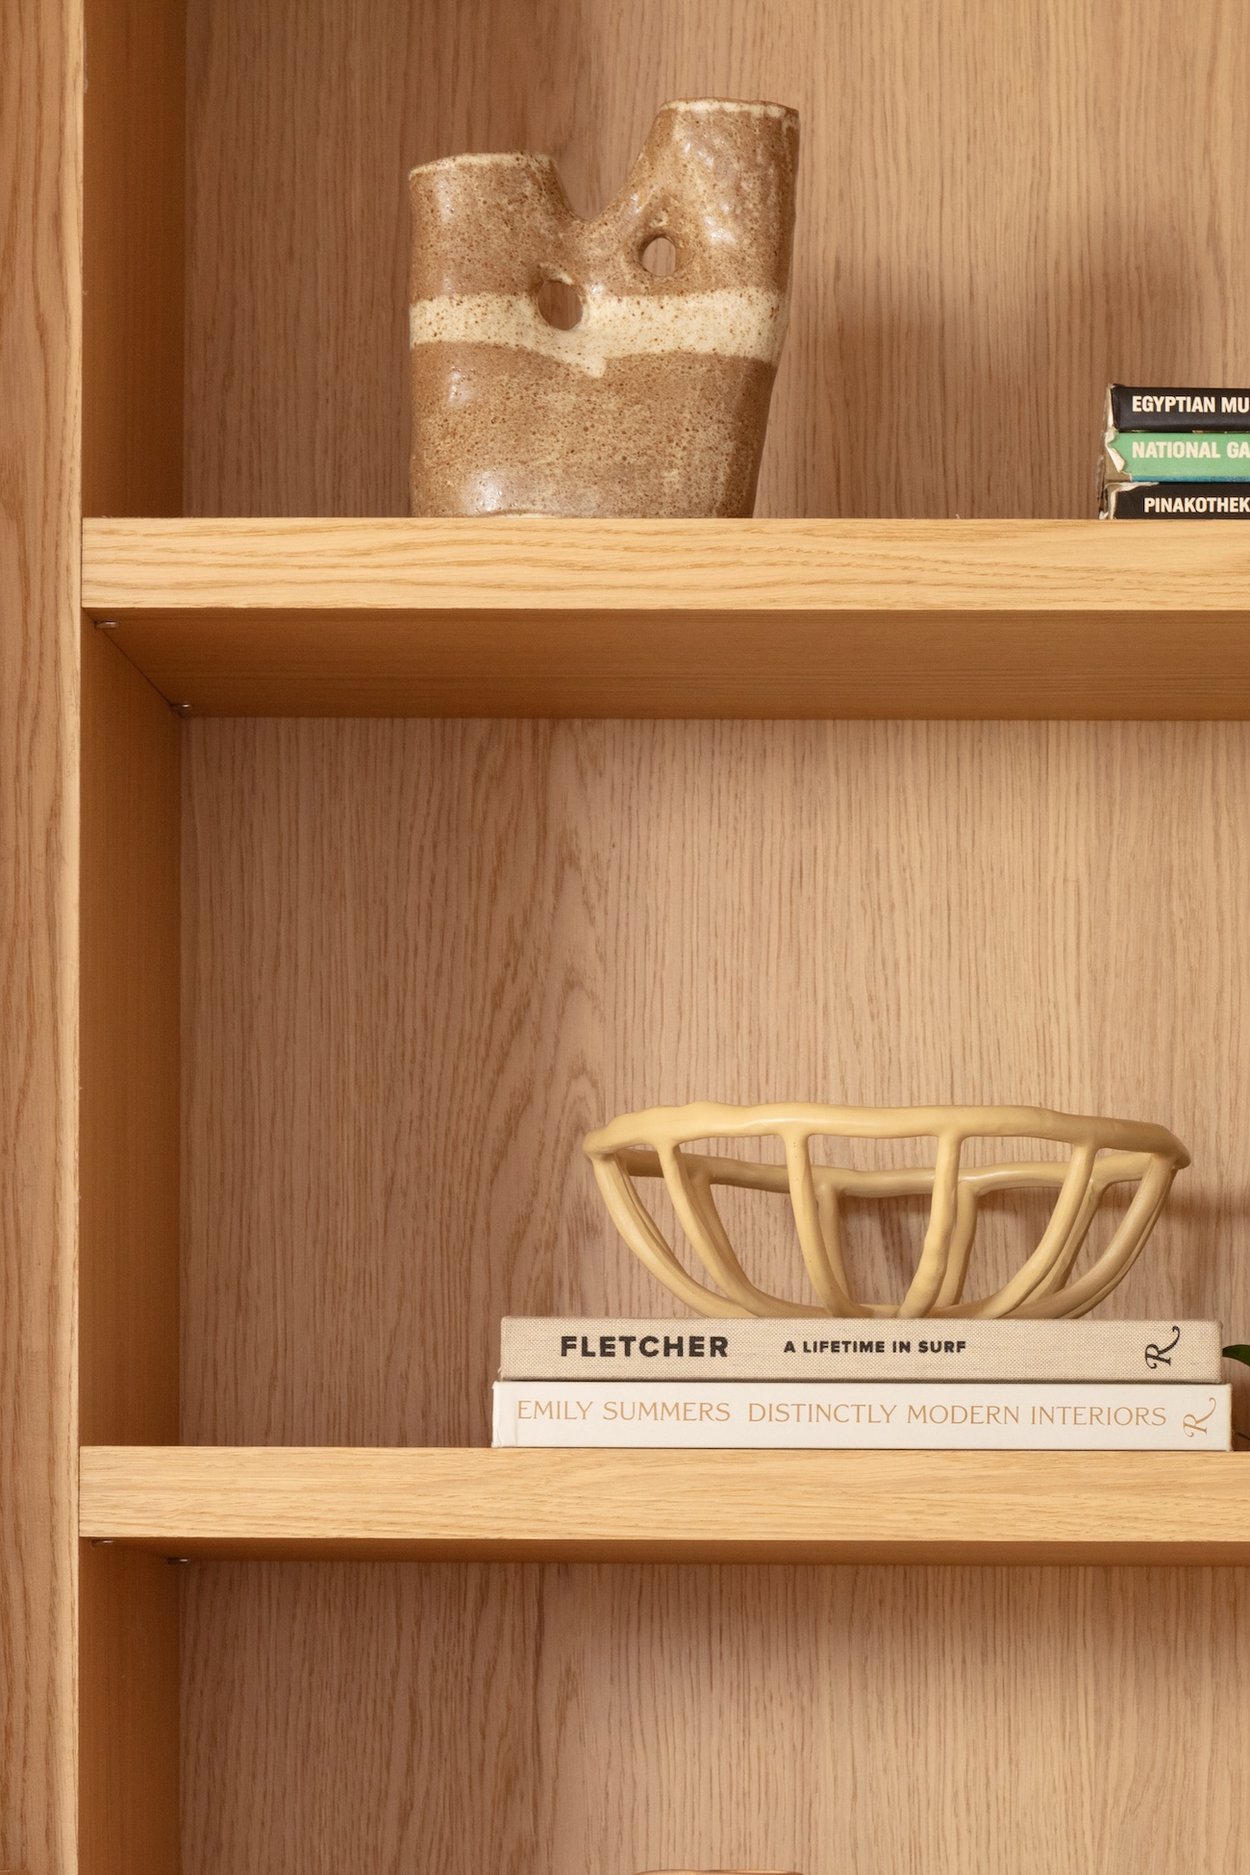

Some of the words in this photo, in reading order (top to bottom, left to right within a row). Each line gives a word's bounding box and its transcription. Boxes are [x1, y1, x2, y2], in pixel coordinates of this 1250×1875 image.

[1132, 396, 1216, 413] EGYPTIAN
[1132, 442, 1220, 459] NATIONAL
[1144, 497, 1250, 513] PINAKOTHEK
[561, 1335, 729, 1358] FLETCHER
[783, 1341, 796, 1353] A
[803, 1340, 885, 1353] LIFETIME
[893, 1341, 911, 1353] IN
[918, 1341, 967, 1353] SURF
[517, 1400, 594, 1420] EMILY
[602, 1401, 731, 1422] SUMMERS
[748, 1403, 898, 1424] DISTINCTLY
[907, 1405, 1019, 1425] MODERN
[1031, 1406, 1167, 1427] INTERIORS
